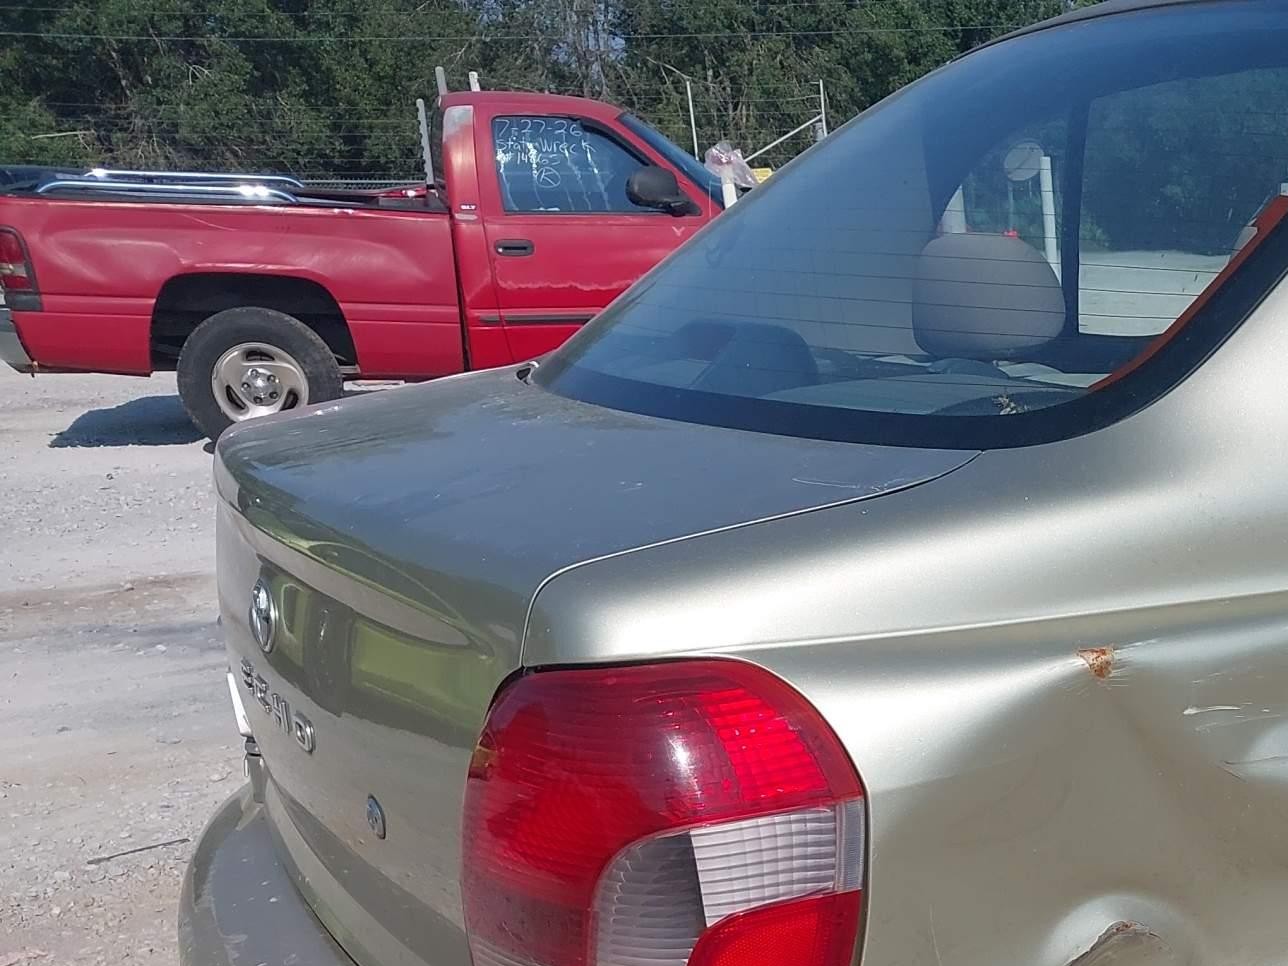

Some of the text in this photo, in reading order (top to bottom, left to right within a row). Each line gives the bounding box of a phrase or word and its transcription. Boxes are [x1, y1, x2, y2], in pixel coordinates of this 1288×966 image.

[496, 119, 583, 137] 7-27-26
[496, 137, 534, 151] Stat
[241, 658, 316, 754] ECHO
